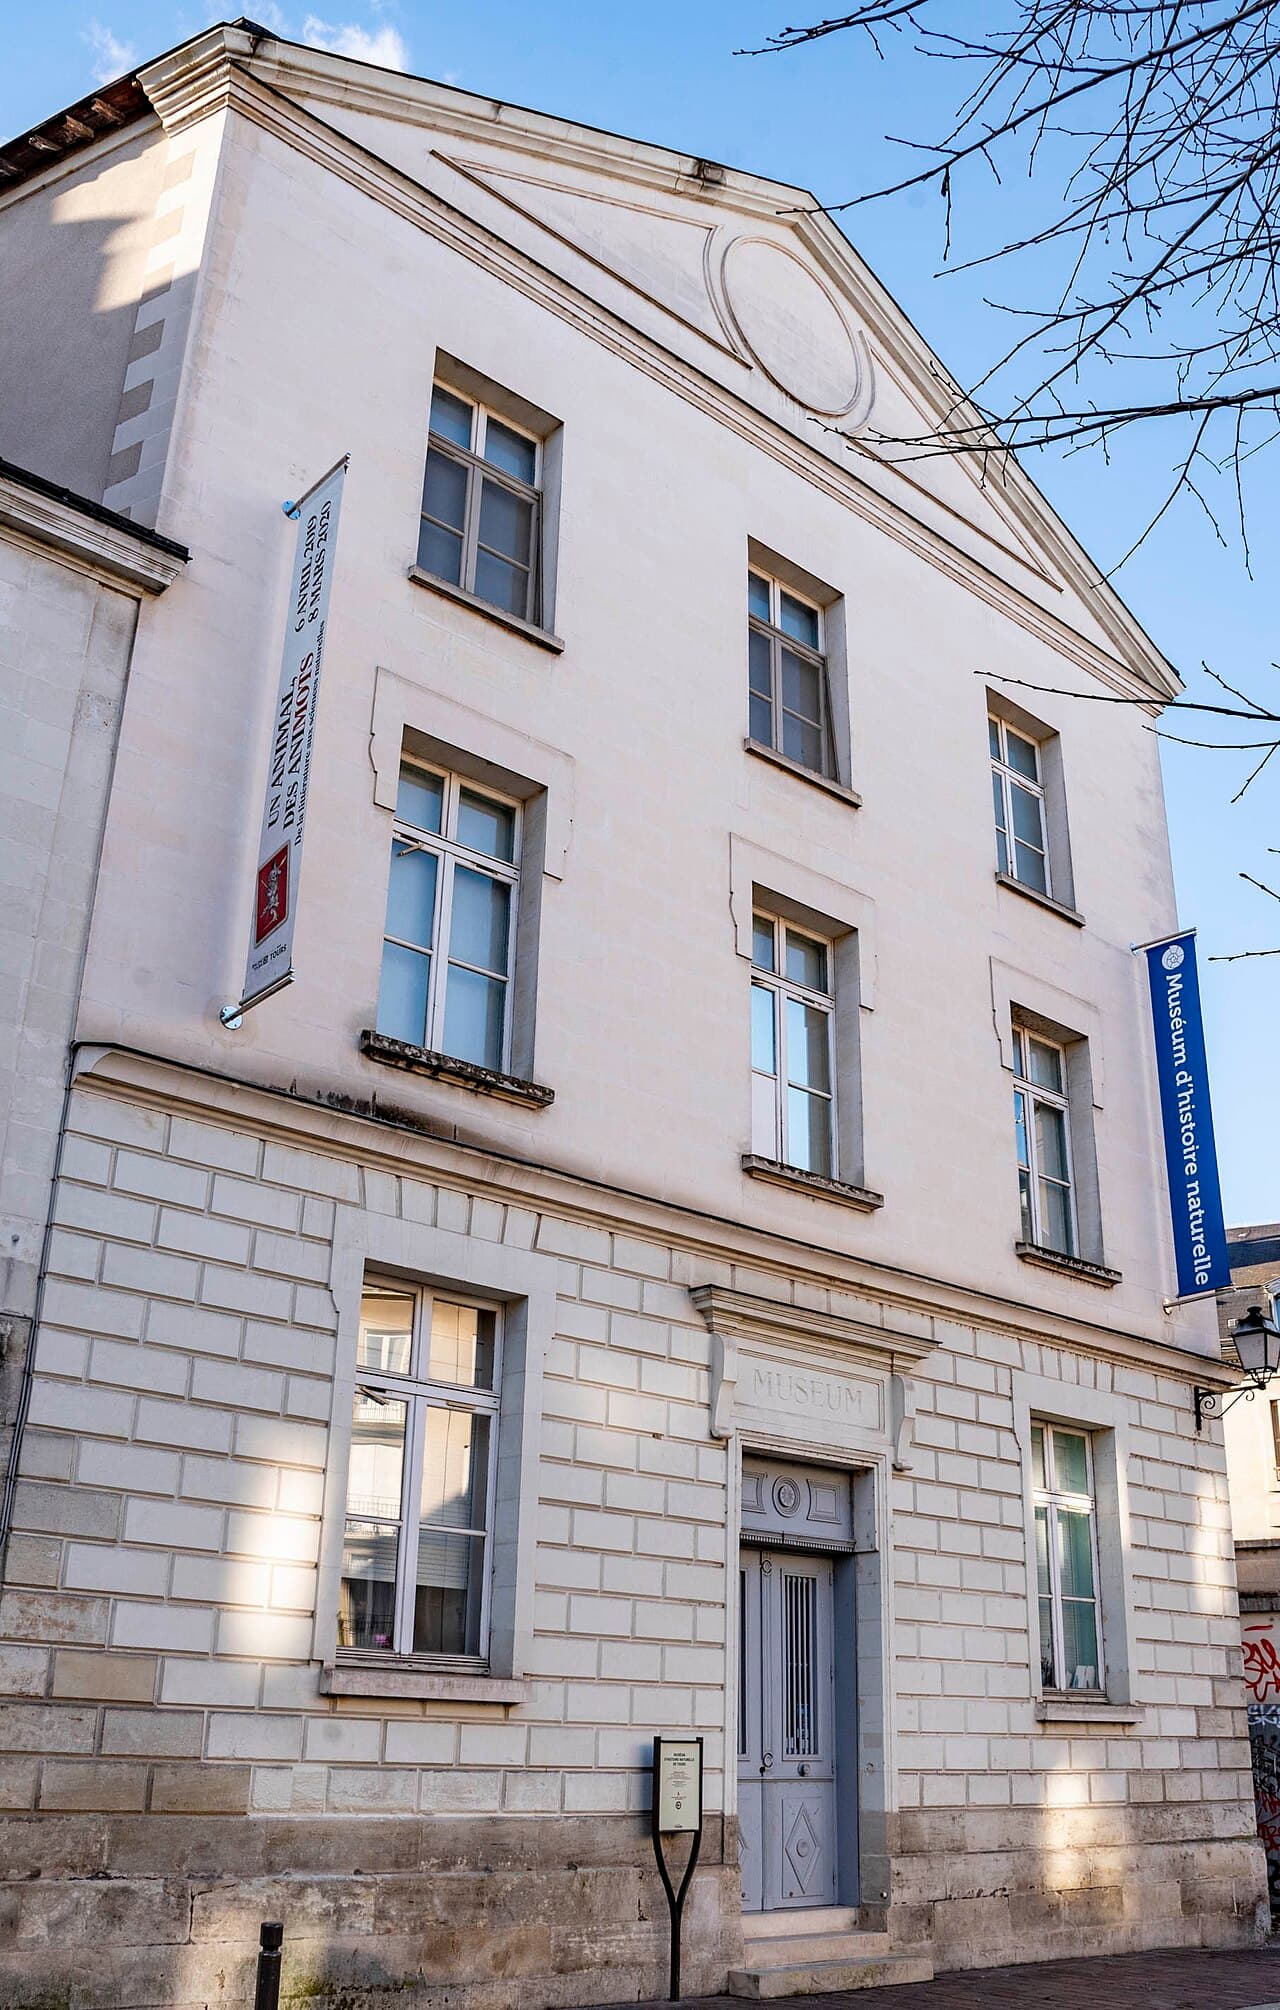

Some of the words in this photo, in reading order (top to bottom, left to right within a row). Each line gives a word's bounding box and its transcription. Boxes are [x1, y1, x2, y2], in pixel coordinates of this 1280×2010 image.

[304, 515, 317, 558] 2019
[317, 500, 331, 548] 2020
[297, 556, 312, 615] AVRIL
[310, 549, 325, 607] MARS
[295, 618, 305, 632] 6
[308, 608, 319, 623] 8
[314, 620, 326, 676] naturelles
[288, 651, 314, 775] ANIMOTS
[309, 678, 319, 727] sciences
[271, 676, 298, 788] ANIMAL,
[306, 727, 314, 749] aux
[268, 794, 281, 830] UN
[283, 781, 299, 830] DES
[297, 811, 304, 825] la
[295, 825, 303, 846] De
[1166, 973, 1188, 1068] Muséum
[1175, 1070, 1200, 1176] d'histoire
[1186, 1179, 1212, 1286] naturelle
